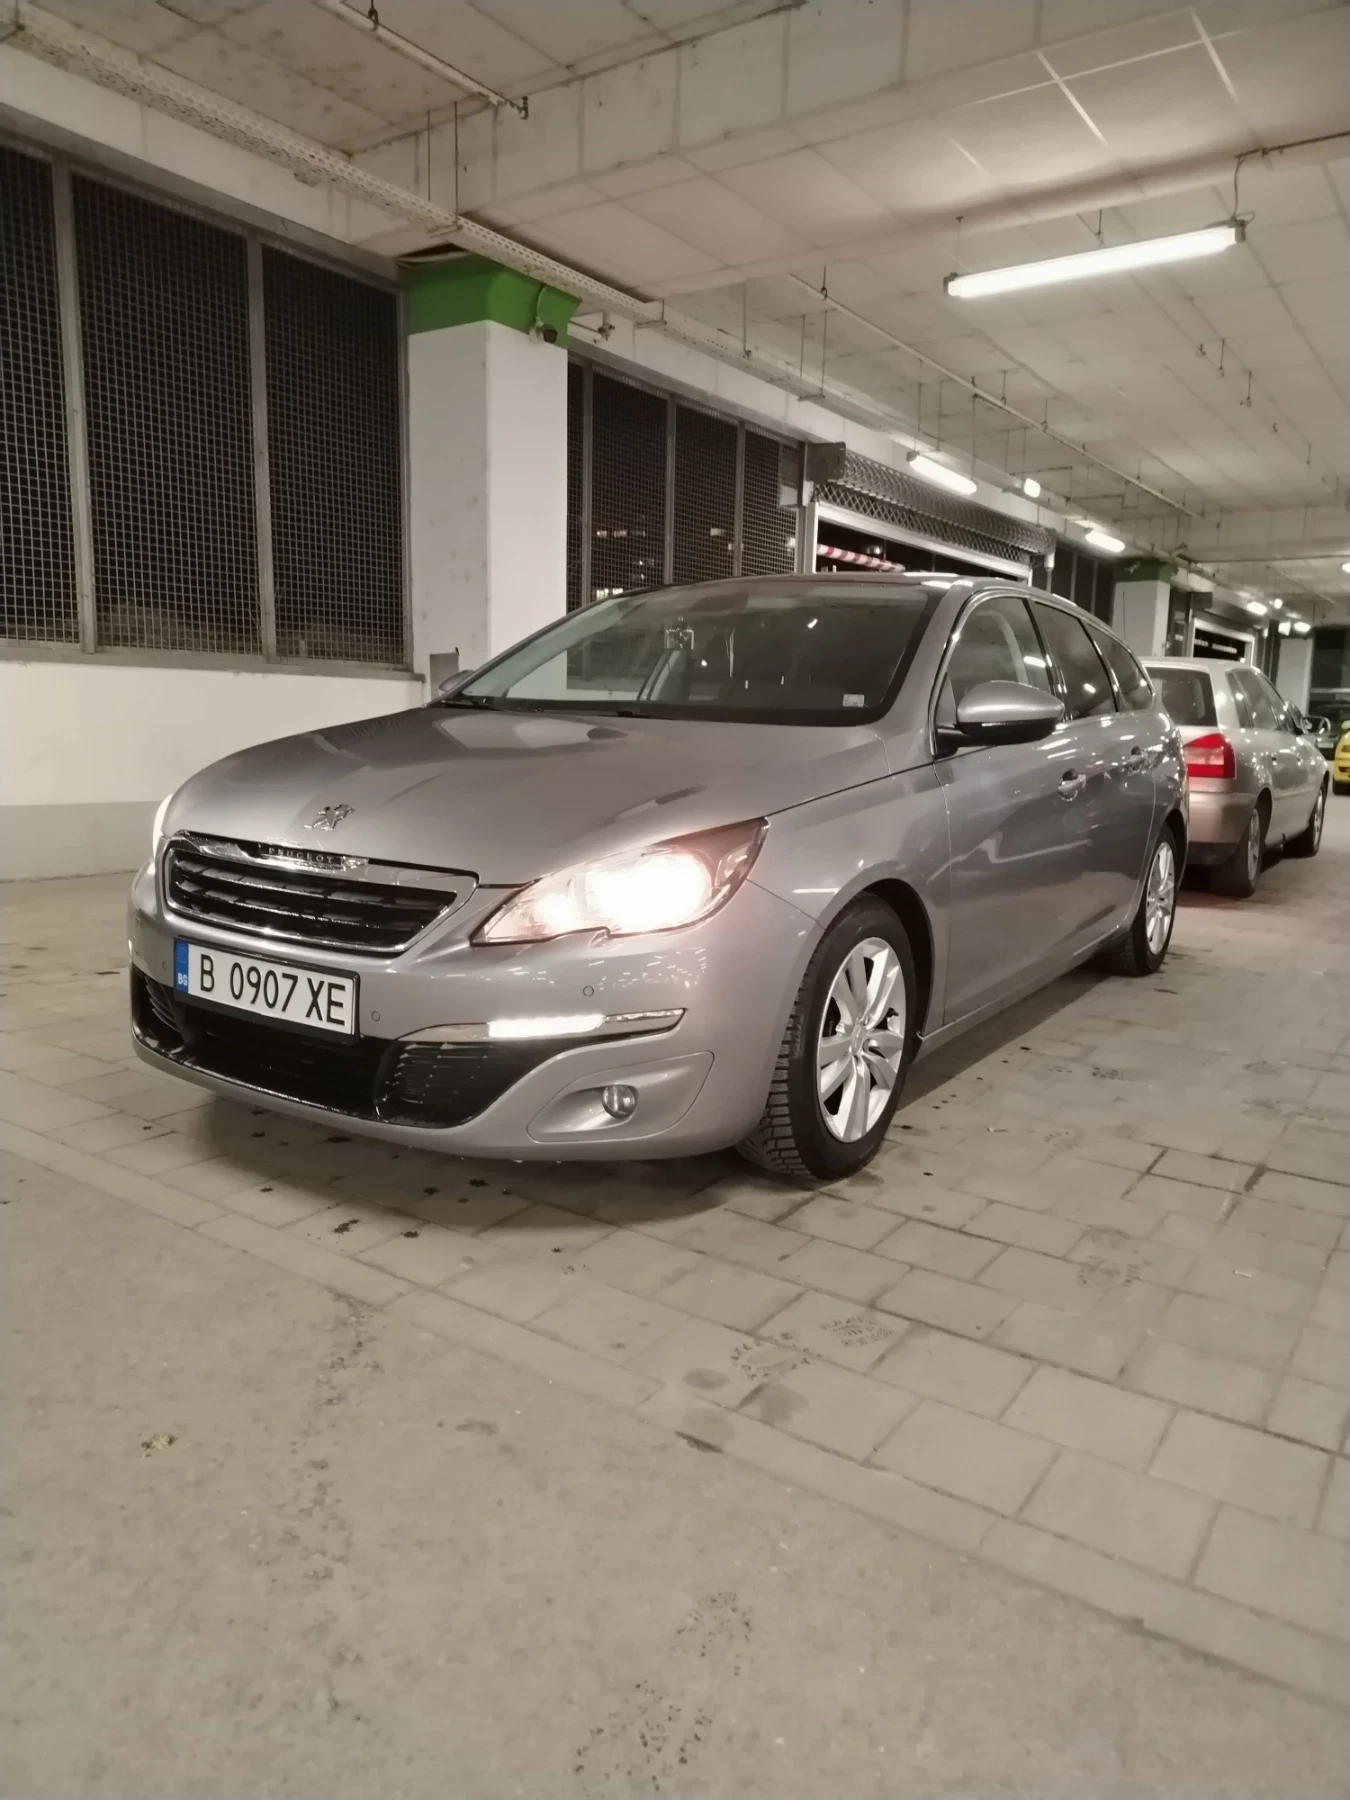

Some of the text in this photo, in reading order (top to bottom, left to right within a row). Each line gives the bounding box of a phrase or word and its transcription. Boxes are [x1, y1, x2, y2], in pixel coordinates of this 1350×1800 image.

[268, 847, 334, 864] PEUGEOT
[177, 972, 188, 987] BG
[200, 953, 346, 1026] B 0907 XE
